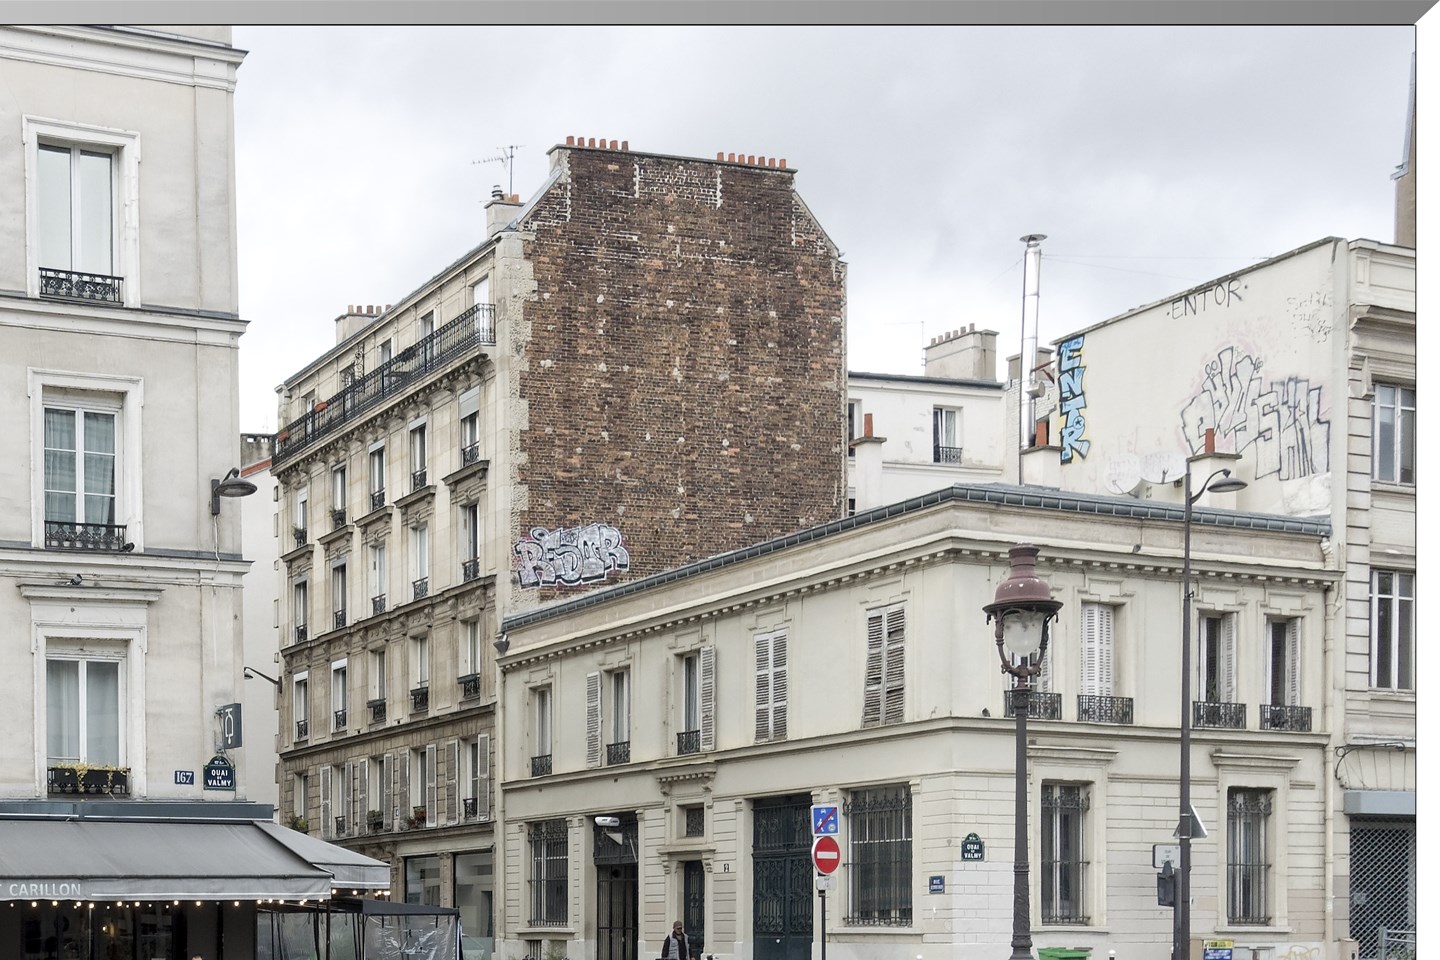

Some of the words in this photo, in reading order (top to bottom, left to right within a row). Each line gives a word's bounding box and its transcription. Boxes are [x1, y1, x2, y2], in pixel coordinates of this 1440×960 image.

[176, 771, 192, 783] 167
[211, 769, 228, 777] QUAI
[207, 779, 231, 787] VALMY
[9, 883, 81, 896] CARILLON
